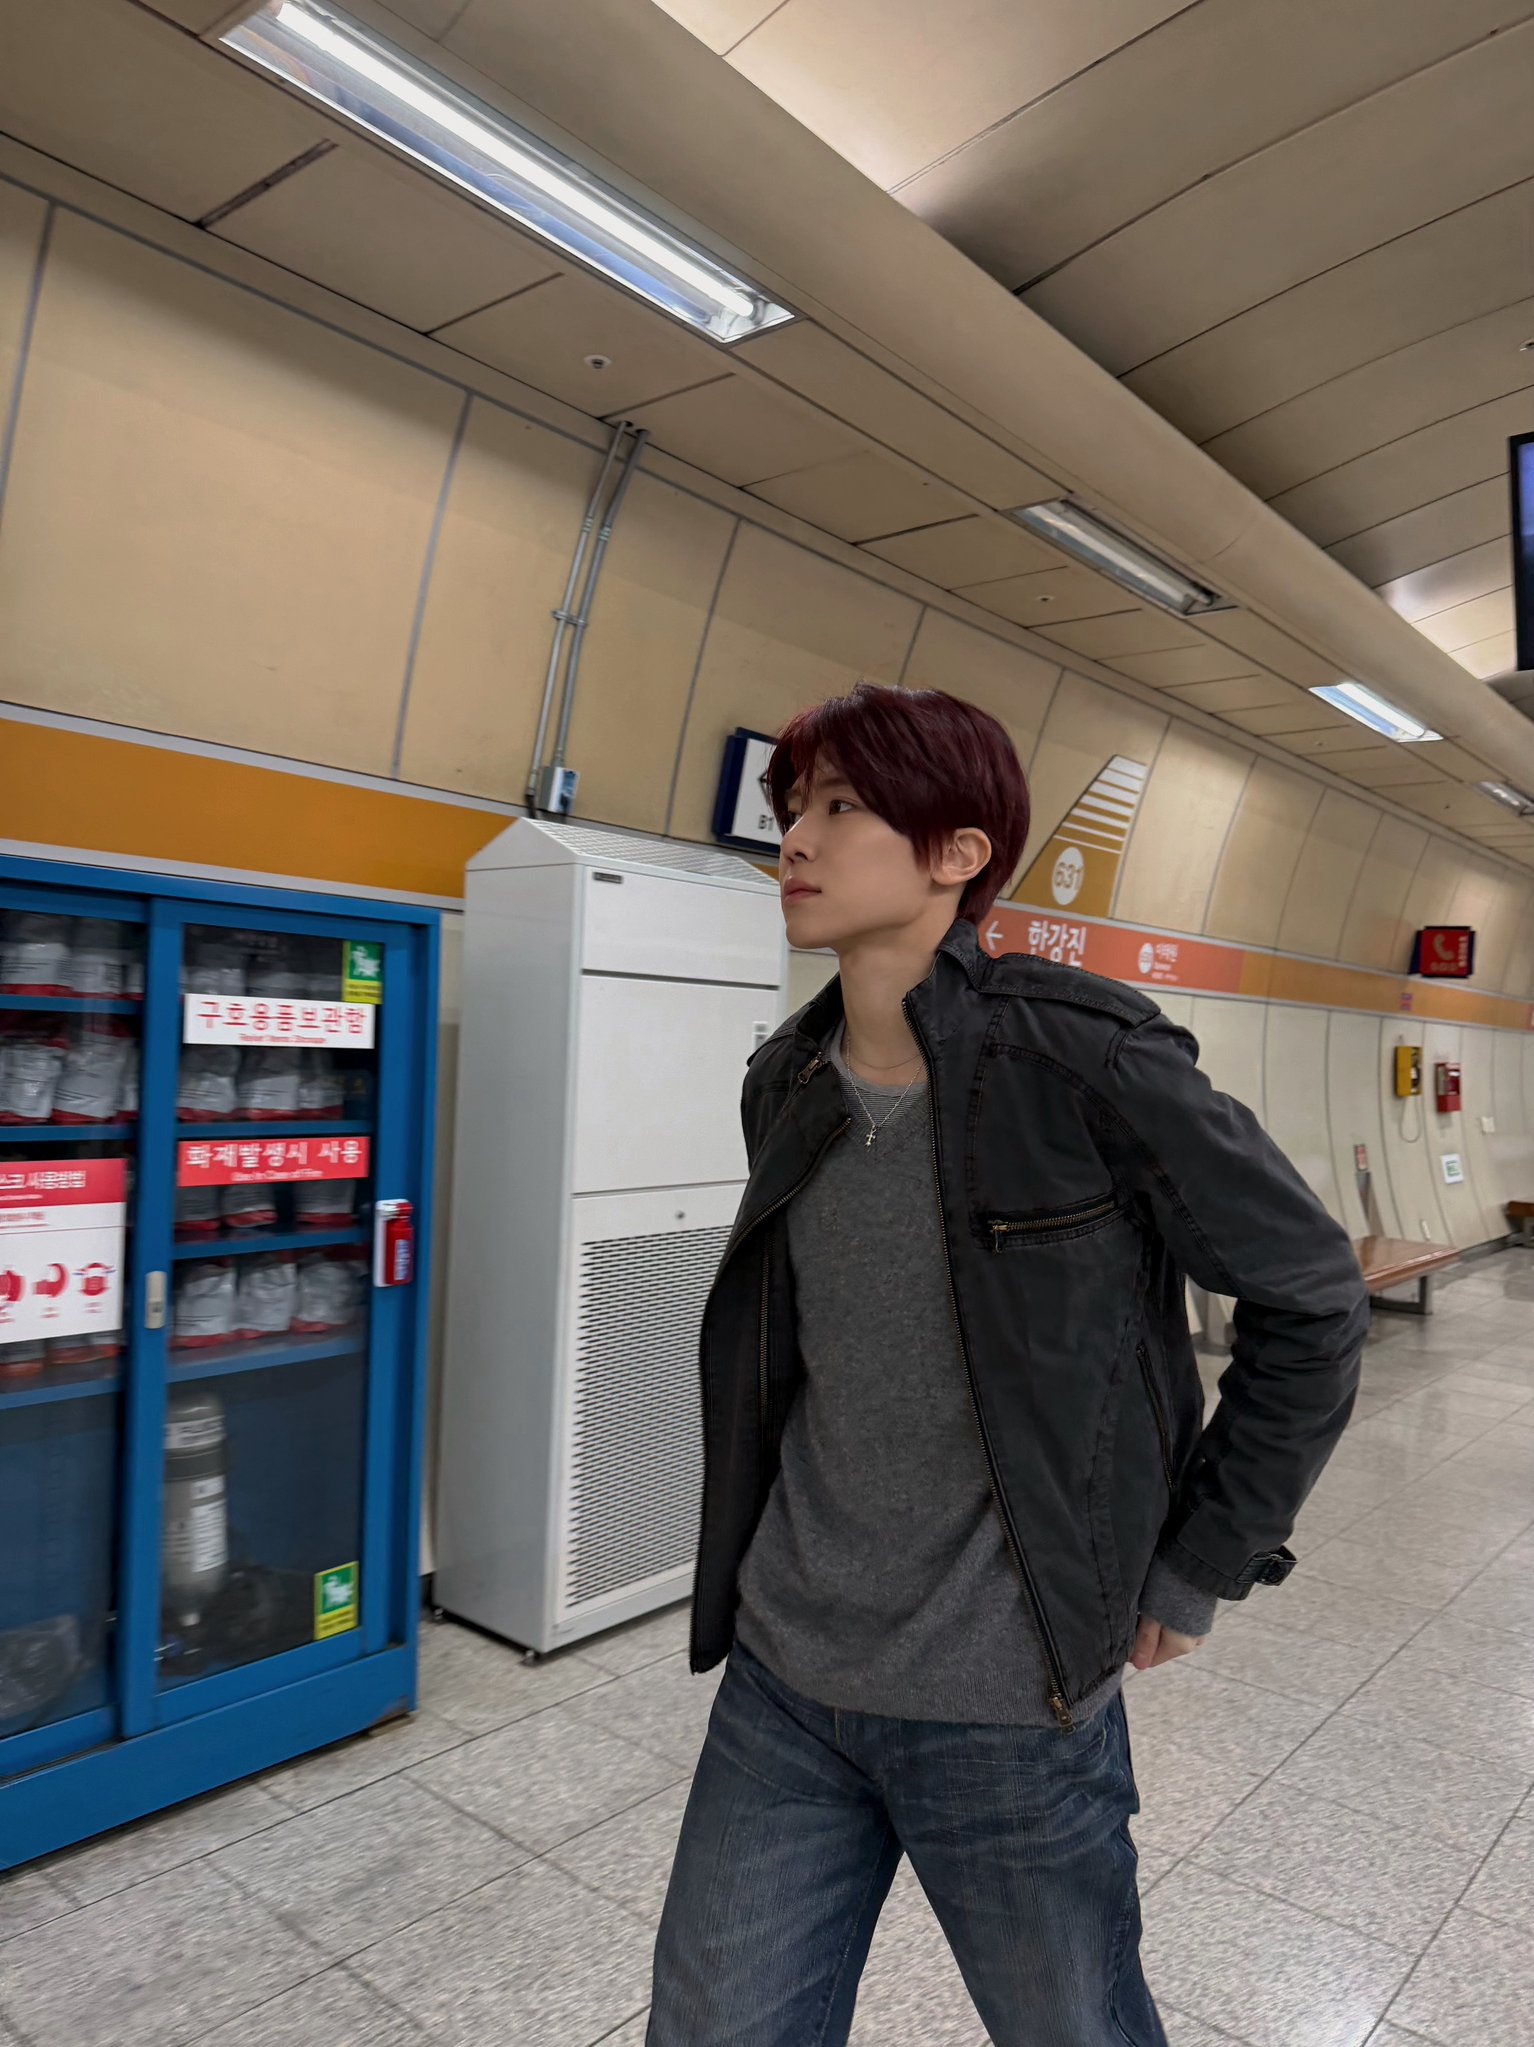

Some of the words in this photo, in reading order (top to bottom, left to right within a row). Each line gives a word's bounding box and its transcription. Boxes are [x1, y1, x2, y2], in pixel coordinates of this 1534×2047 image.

[1054, 861, 1083, 891] 631
[197, 1001, 367, 1034] 구호용품보관함
[186, 1142, 308, 1168] 화재발생시
[317, 1140, 363, 1164] 사용
